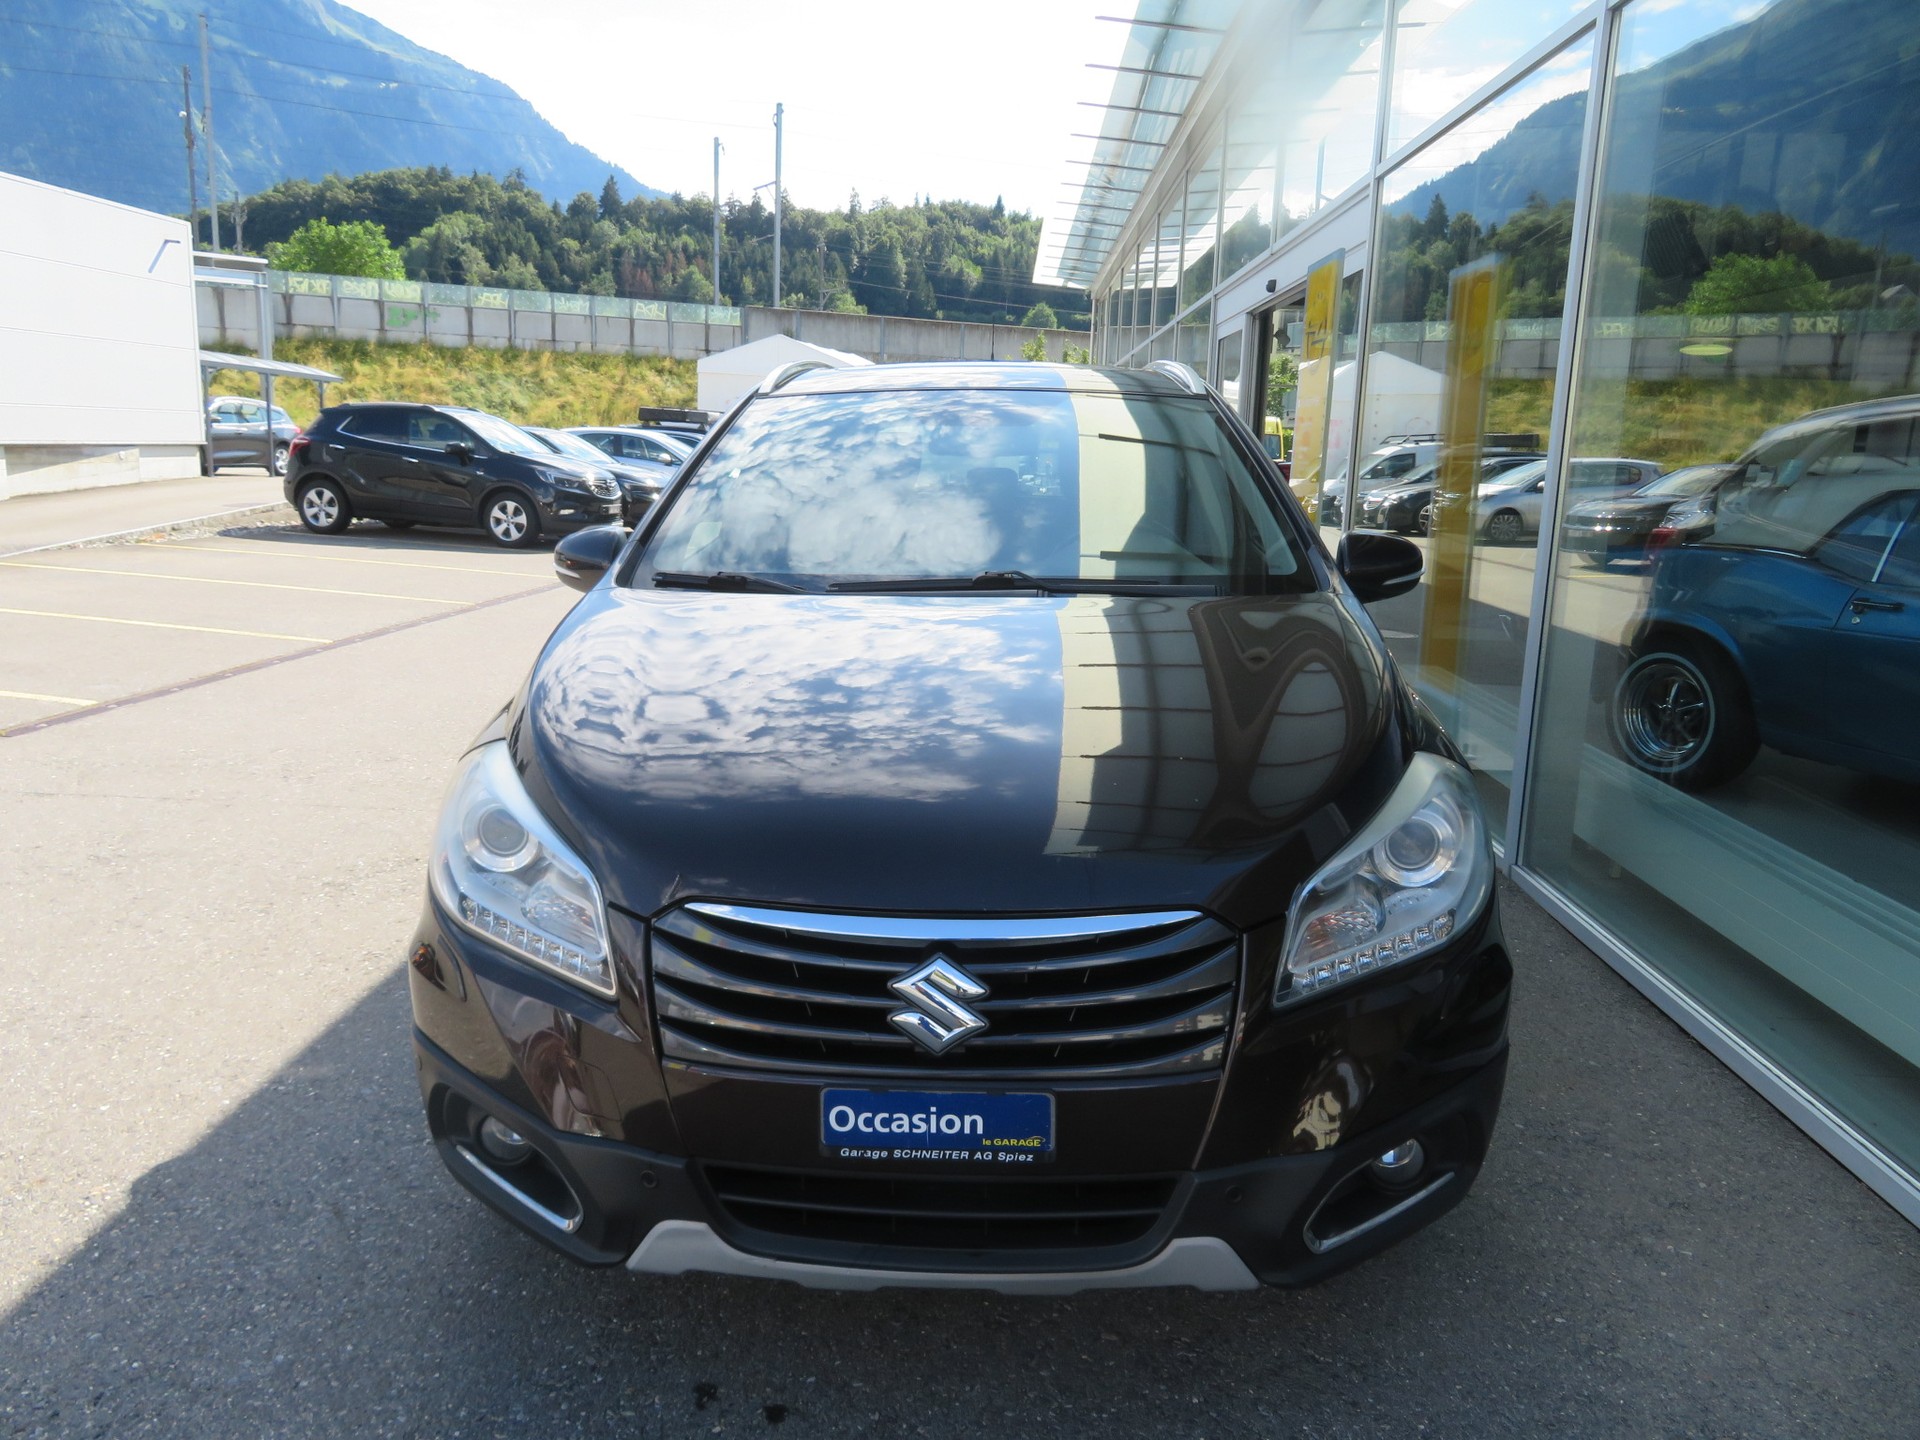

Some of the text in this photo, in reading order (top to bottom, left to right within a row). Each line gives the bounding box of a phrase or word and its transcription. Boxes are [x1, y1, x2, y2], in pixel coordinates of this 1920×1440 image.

[828, 1105, 984, 1135] Occasion
[982, 1138, 1042, 1147] le GARAGE
[840, 1148, 1034, 1162] Garage SCHNEITER AG Spiez
